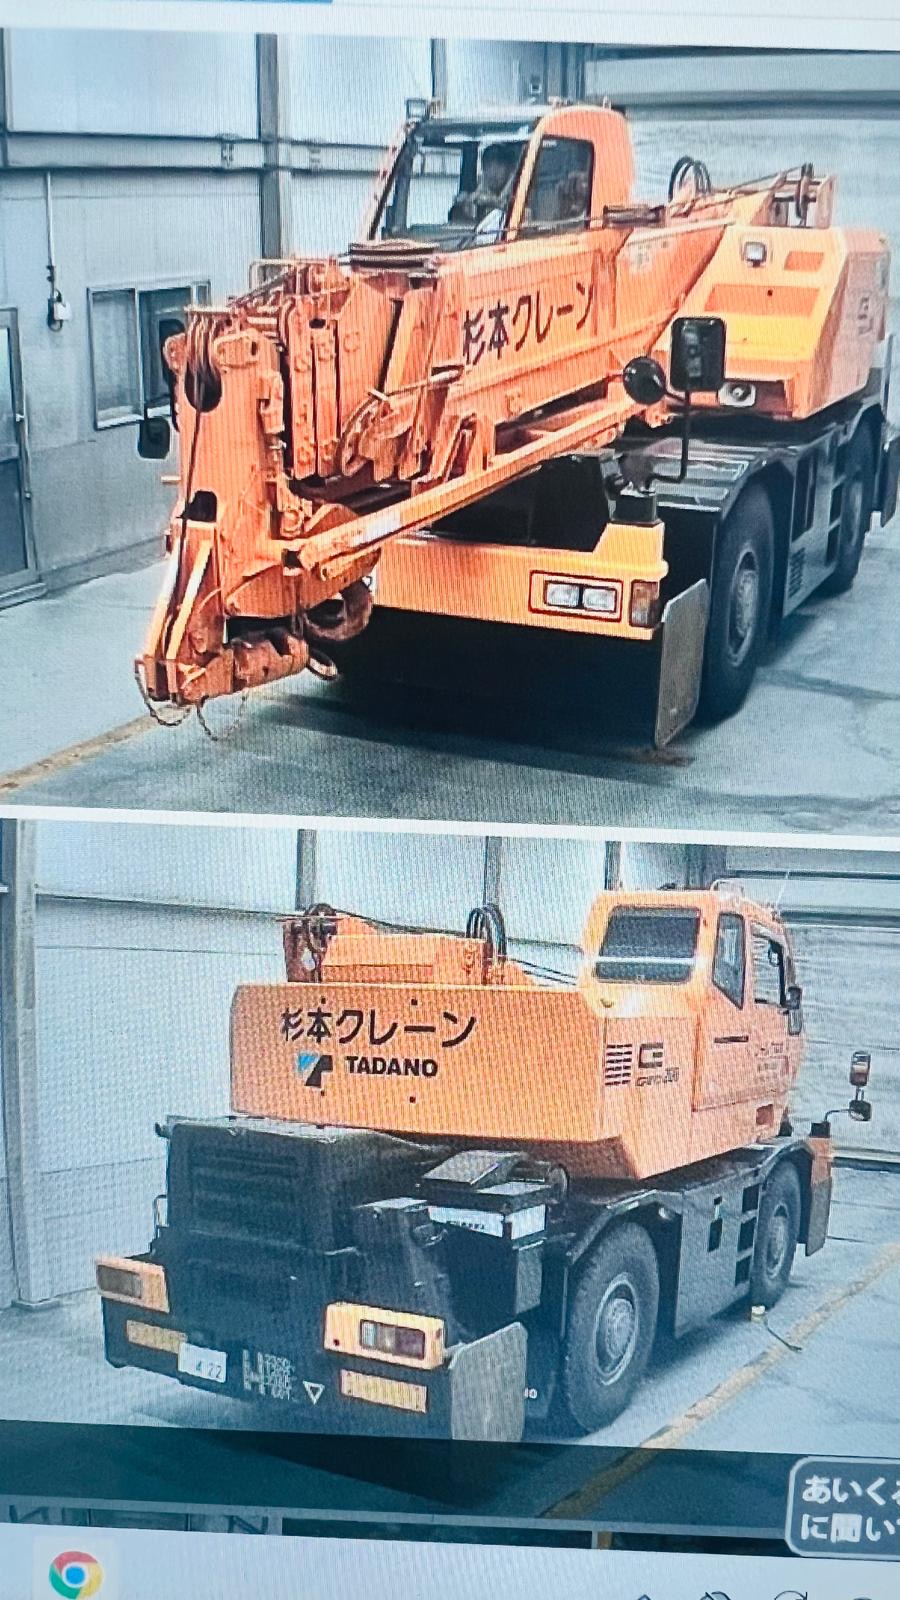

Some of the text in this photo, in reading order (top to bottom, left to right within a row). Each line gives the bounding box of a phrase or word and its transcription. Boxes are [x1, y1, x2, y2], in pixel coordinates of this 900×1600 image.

[462, 282, 594, 366] 杉本クレーン
[280, 1007, 477, 1048] 杉本クレーン
[345, 1056, 438, 1077] TADANO
